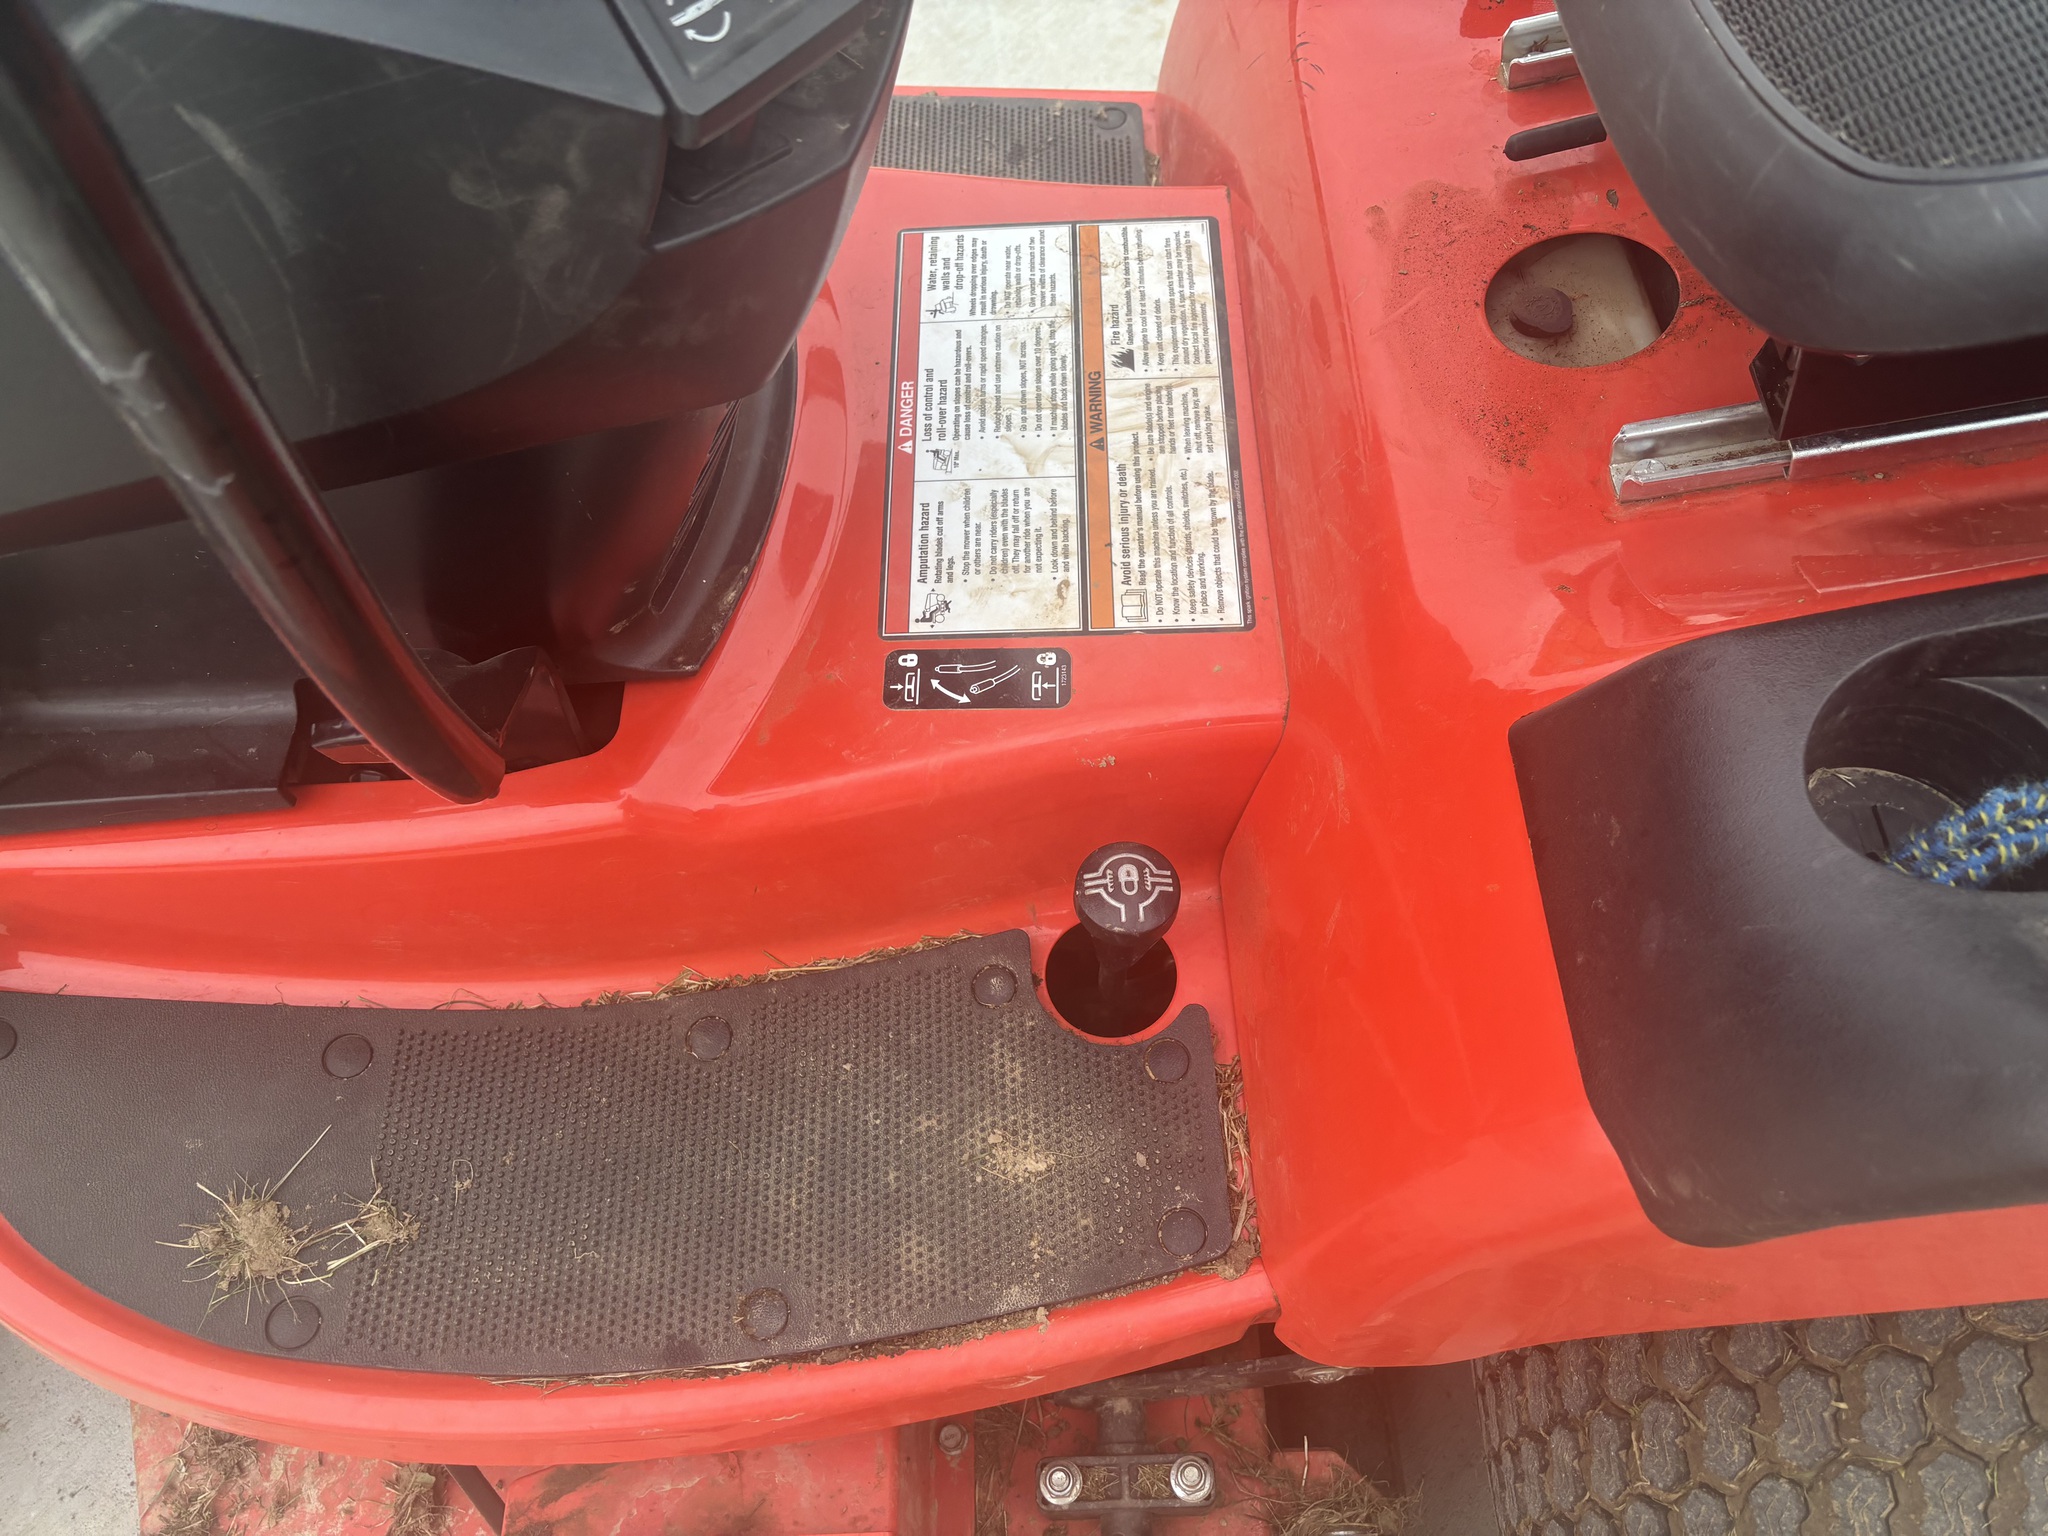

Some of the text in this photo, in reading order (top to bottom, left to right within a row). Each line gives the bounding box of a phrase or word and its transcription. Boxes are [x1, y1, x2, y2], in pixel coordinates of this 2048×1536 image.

[927, 237, 940, 291] Water, retaining
[941, 258, 950, 290] walls and
[955, 235, 965, 290] drop-off hazards
[1110, 305, 1120, 345] Fire hazard
[924, 369, 933, 382] and
[923, 385, 933, 411] control
[953, 387, 962, 404] slopes
[1035, 393, 1043, 412] operate
[1088, 371, 1102, 434] WARNING
[900, 381, 914, 436] DANGER
[937, 380, 947, 441] roll-over hazard
[922, 424, 932, 441] Loss
[953, 414, 961, 440] Operating
[1205, 423, 1214, 443] parking
[1132, 432, 1141, 454] product.
[1134, 468, 1142, 483] using
[1180, 469, 1188, 480] etc.)
[990, 490, 998, 519] (especially
[1062, 518, 1070, 542] backing.
[1117, 464, 1131, 586] Avoid serious injury or death
[918, 503, 930, 584] Amputation hazard
[1035, 534, 1043, 562] expecting
[1136, 528, 1146, 557] operator's
[1184, 532, 1193, 554] (guards,
[1212, 537, 1220, 553] could
[946, 556, 955, 570] legs.
[1012, 549, 1021, 563] They
[1198, 552, 1206, 576] working.
[935, 558, 944, 583] Rotating
[962, 562, 971, 575] Stop
[1214, 567, 1224, 588] objects
[1154, 570, 1163, 592] operate
[1187, 580, 1196, 598] safety
[1200, 591, 1209, 606] place
